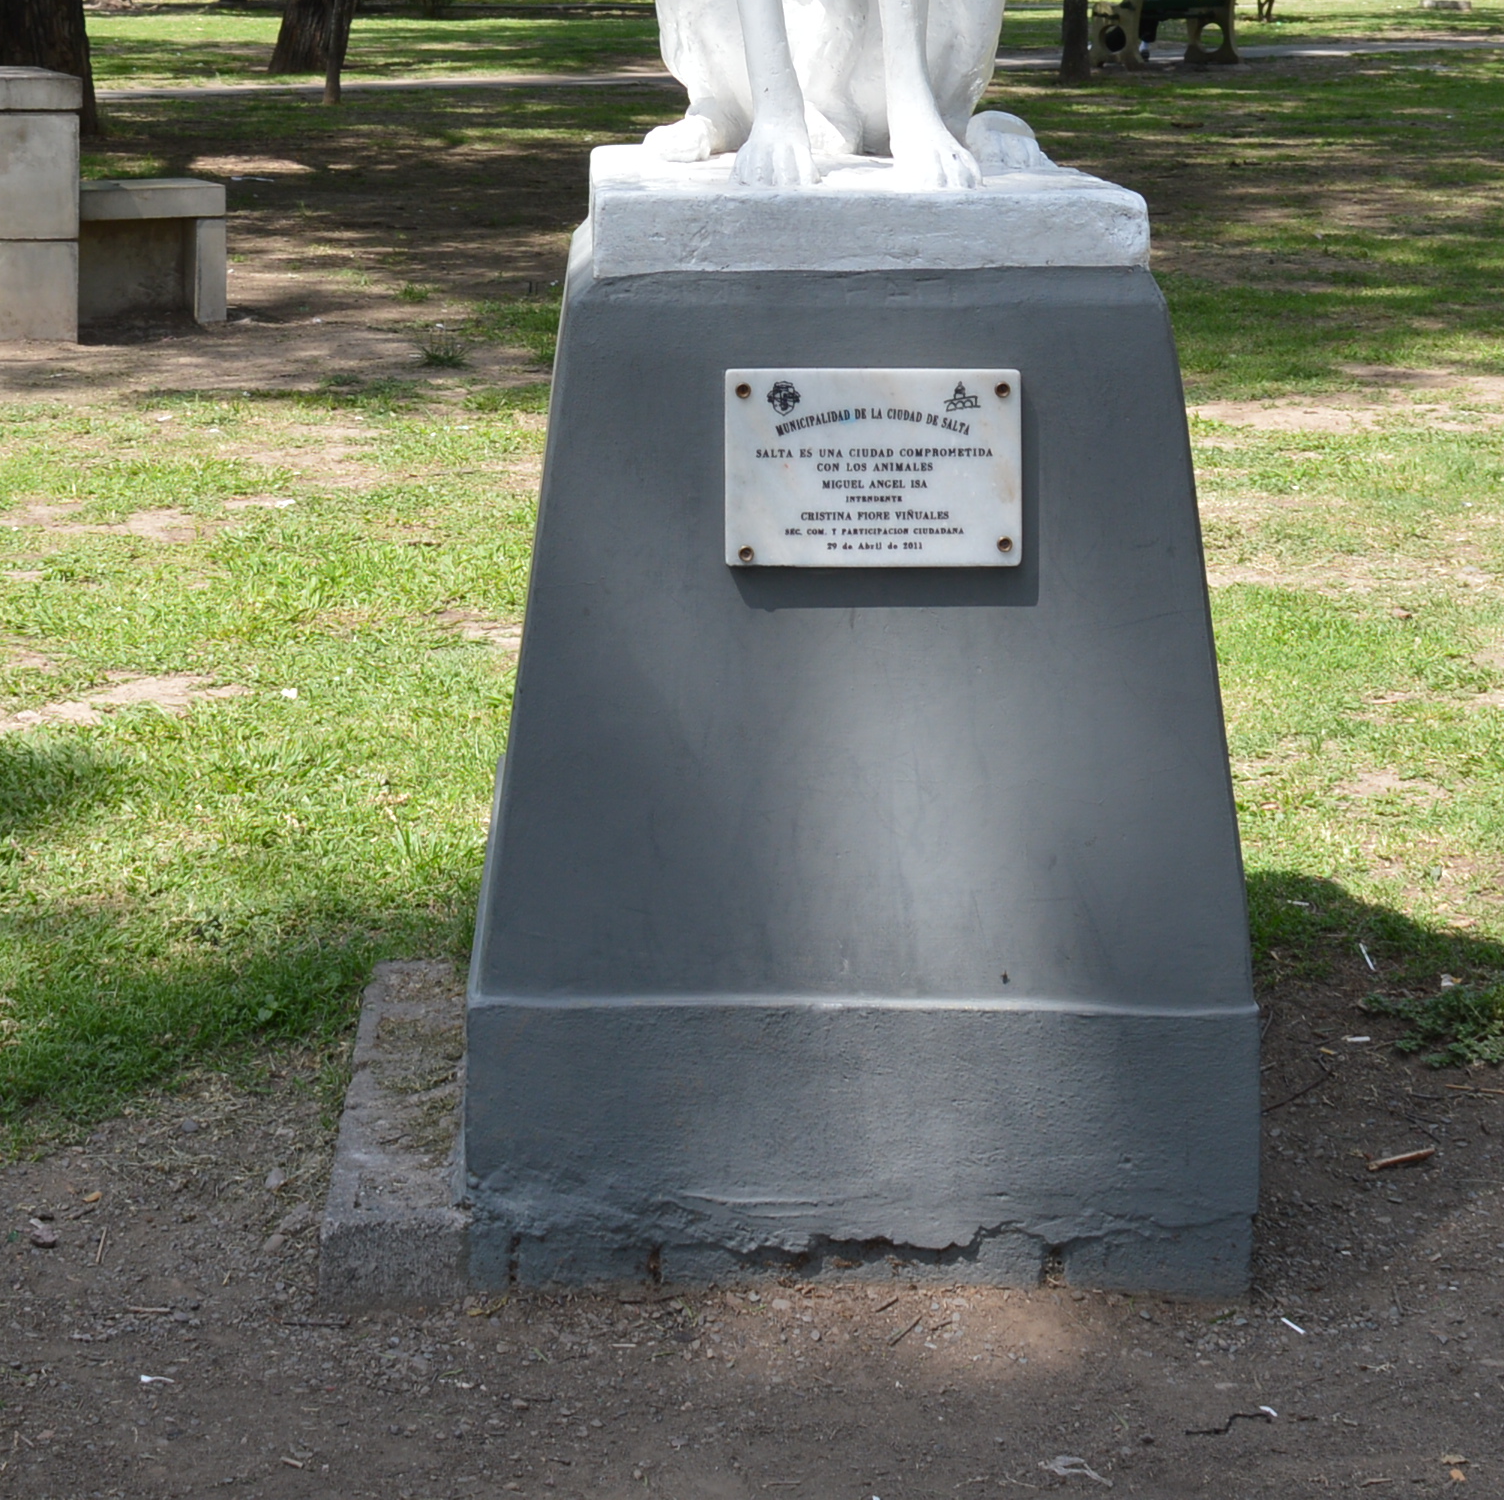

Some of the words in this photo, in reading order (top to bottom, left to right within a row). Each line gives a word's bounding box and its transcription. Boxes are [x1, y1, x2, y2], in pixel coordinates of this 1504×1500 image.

[775, 409, 850, 437] MUNICIPALIDAD
[854, 408, 867, 420] DE
[871, 407, 882, 420] LA
[887, 408, 923, 423] CIUDAD
[926, 413, 939, 426] DE
[941, 417, 970, 436] SALTA
[755, 448, 794, 459] SALTA
[799, 448, 813, 458] ES
[818, 448, 844, 458] UNA
[848, 448, 894, 458] CIUDAD
[899, 447, 993, 458] COMPROMETIDA
[816, 462, 840, 472] CON
[846, 462, 867, 472] LOS
[873, 462, 933, 472] ANIMALES
[821, 479, 865, 490] MIGUEL
[868, 479, 906, 490] ANGEL
[910, 479, 928, 489] ISA
[845, 494, 903, 503] INTENDENTE
[800, 511, 852, 521] CRISTINA
[857, 511, 890, 521] FIORE
[895, 509, 949, 521] VIÑUALES
[841, 527, 909, 536] PARTICIPACION
[912, 527, 964, 535] CIUDADANA
[827, 542, 837, 551] 29
[842, 542, 853, 551] de
[858, 541, 883, 551] Abril
[887, 541, 898, 550] de
[903, 541, 923, 550] 2011
